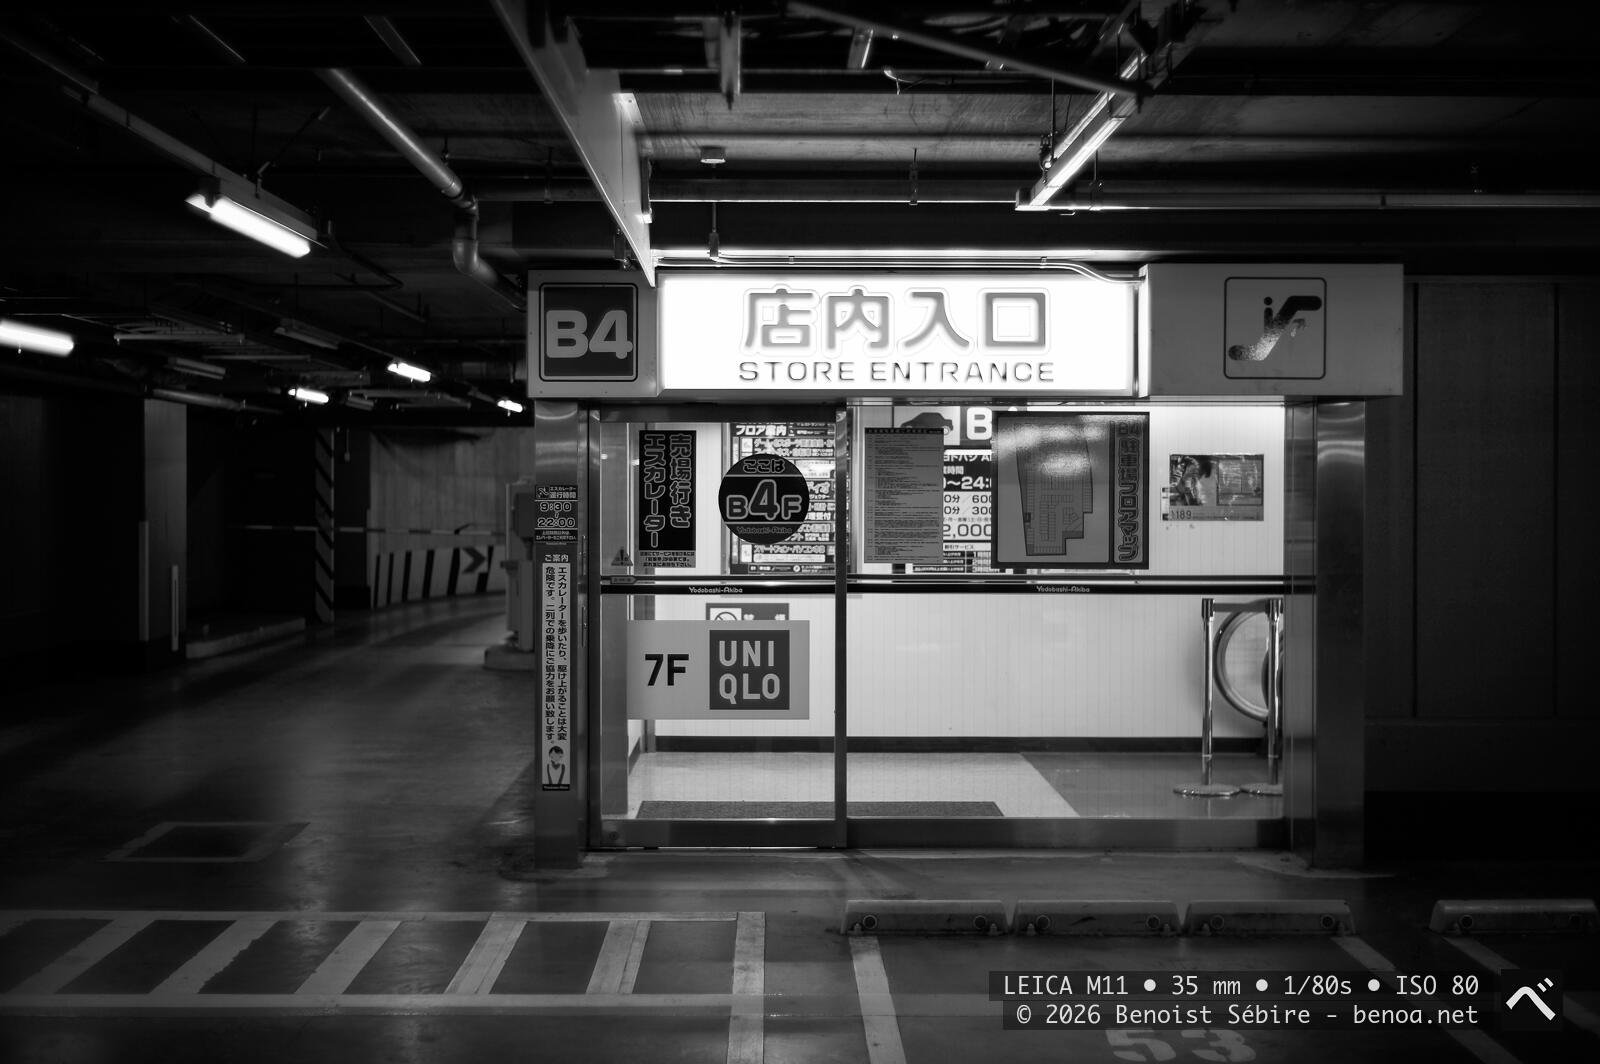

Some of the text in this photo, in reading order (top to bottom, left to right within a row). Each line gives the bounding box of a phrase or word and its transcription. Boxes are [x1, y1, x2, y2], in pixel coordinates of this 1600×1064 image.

[546, 310, 633, 359] B4
[743, 287, 1048, 352] 店内入口
[739, 361, 1054, 383] STORE ENTRANCE
[669, 433, 691, 528] 売場行き
[743, 459, 786, 474] ここは
[540, 502, 571, 511] 9:30
[644, 433, 666, 548] エスカレーター
[726, 479, 803, 521] B4F
[537, 518, 575, 527] 22:00
[645, 653, 690, 686] 7F
[719, 640, 774, 667] UNI
[719, 673, 781, 704] QLO
